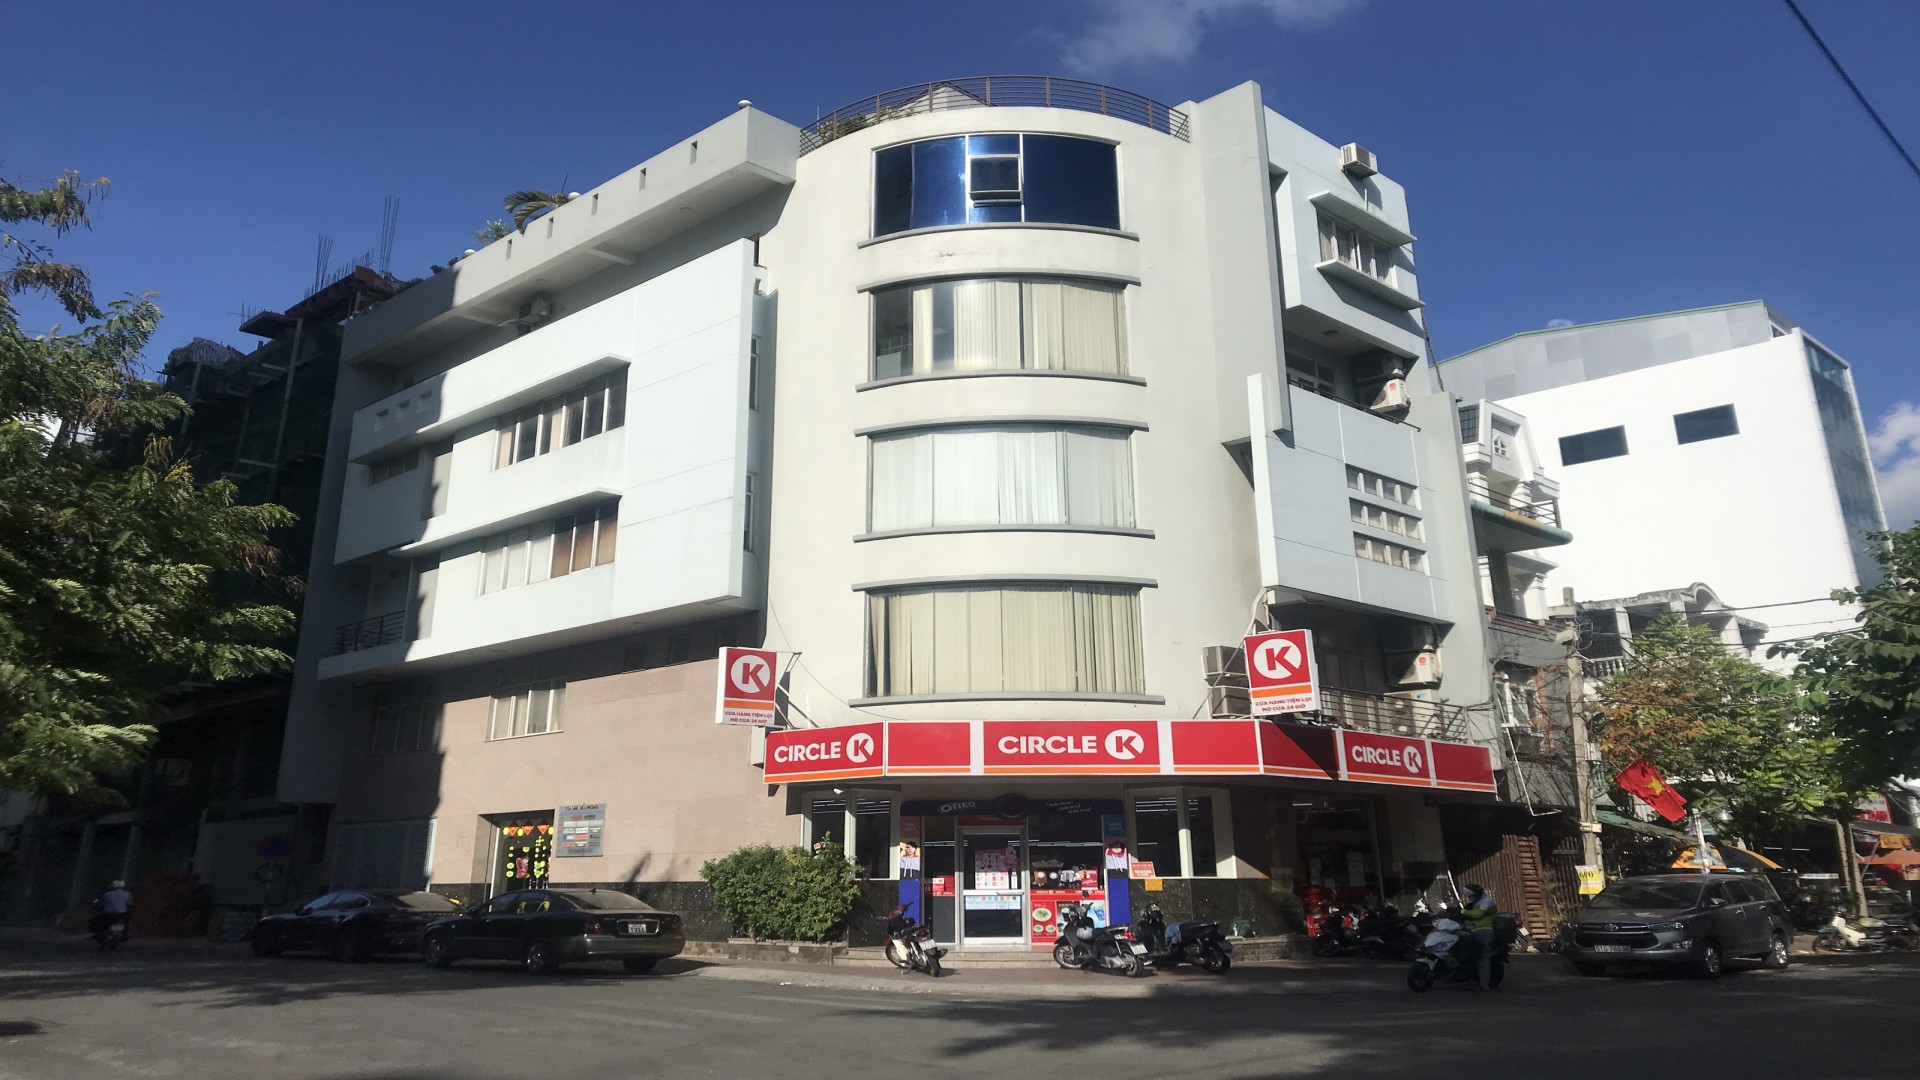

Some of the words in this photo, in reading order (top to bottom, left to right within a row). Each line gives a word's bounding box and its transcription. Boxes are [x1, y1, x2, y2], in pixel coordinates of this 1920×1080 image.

[774, 741, 841, 763] CIRCLE
[998, 735, 1097, 754] CIRCLE
[1351, 745, 1401, 767] CIRCLE
[940, 801, 976, 813] OREO
